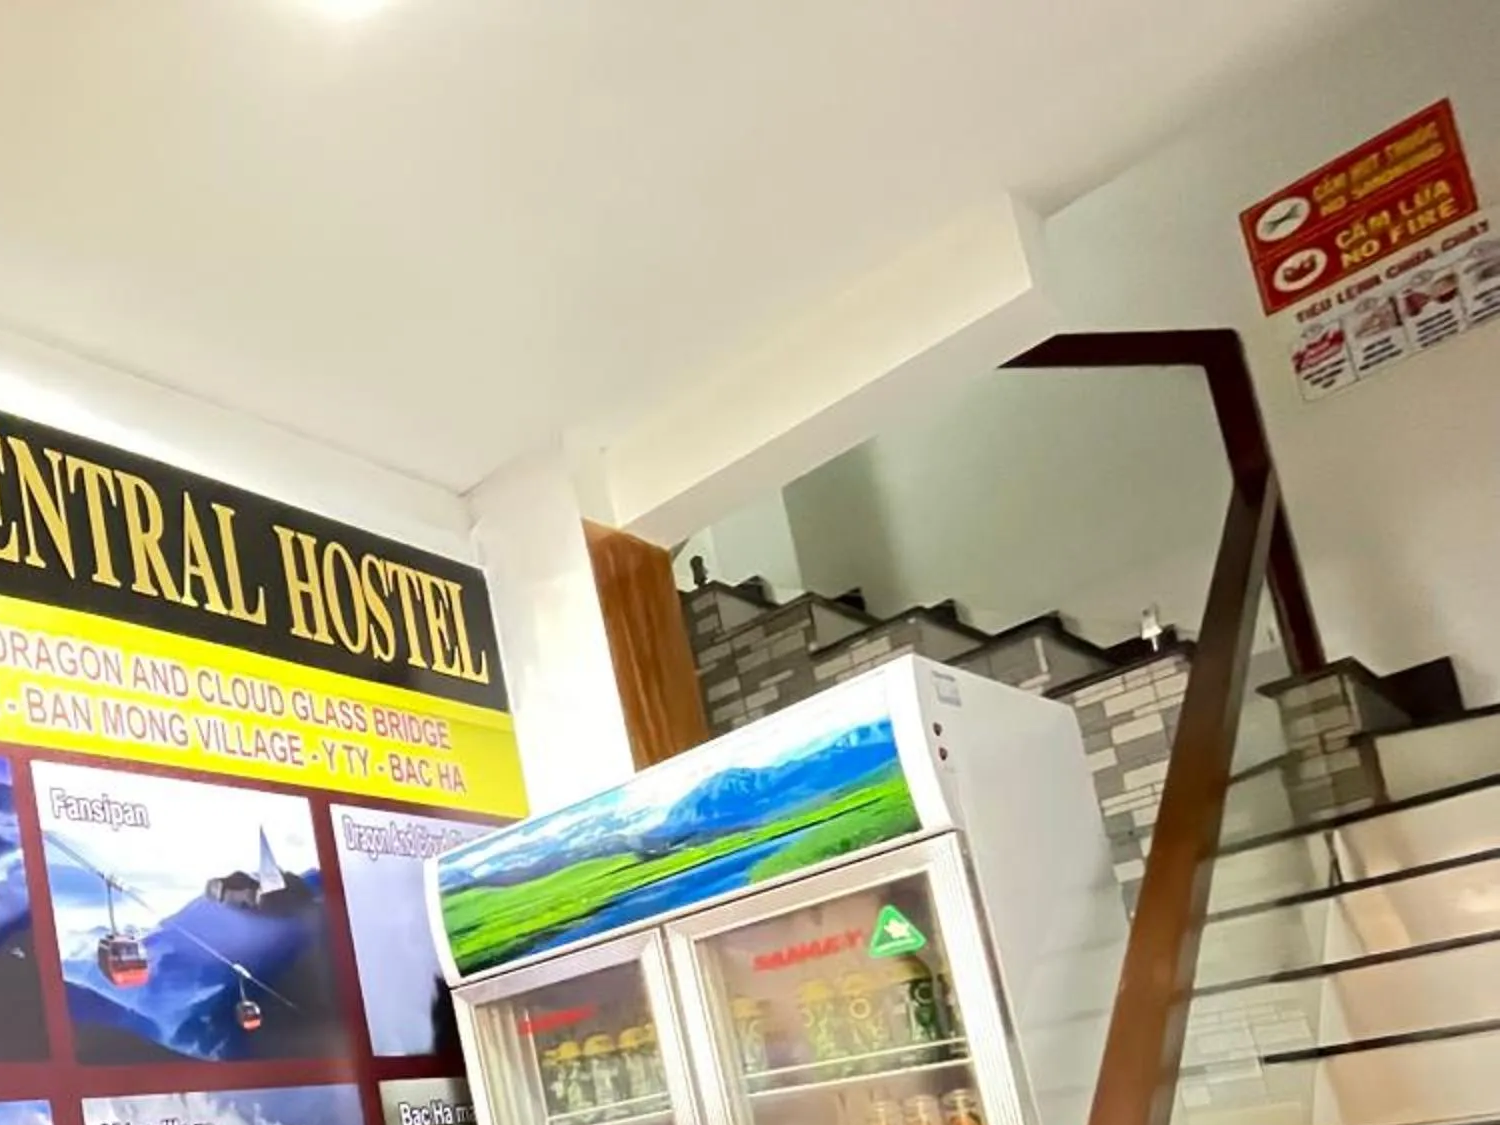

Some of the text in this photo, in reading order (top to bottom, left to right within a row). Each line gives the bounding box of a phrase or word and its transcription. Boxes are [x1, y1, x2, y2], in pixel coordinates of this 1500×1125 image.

[1341, 198, 1459, 268] NO FIRE
[274, 524, 489, 685] HOSTEL
[26, 687, 93, 732] BAN
[102, 700, 189, 747] MONG
[194, 716, 305, 767] VILLAGE
[322, 739, 336, 771] Y
[341, 744, 369, 777] TY
[387, 753, 433, 788] BAC
[436, 760, 468, 793] HA
[132, 656, 189, 698] AND
[197, 670, 285, 717] CLOUD
[292, 690, 368, 734] GLASS
[372, 706, 453, 750] BRIDGE
[49, 786, 150, 832] Fansipan
[342, 813, 391, 861] Dragon
